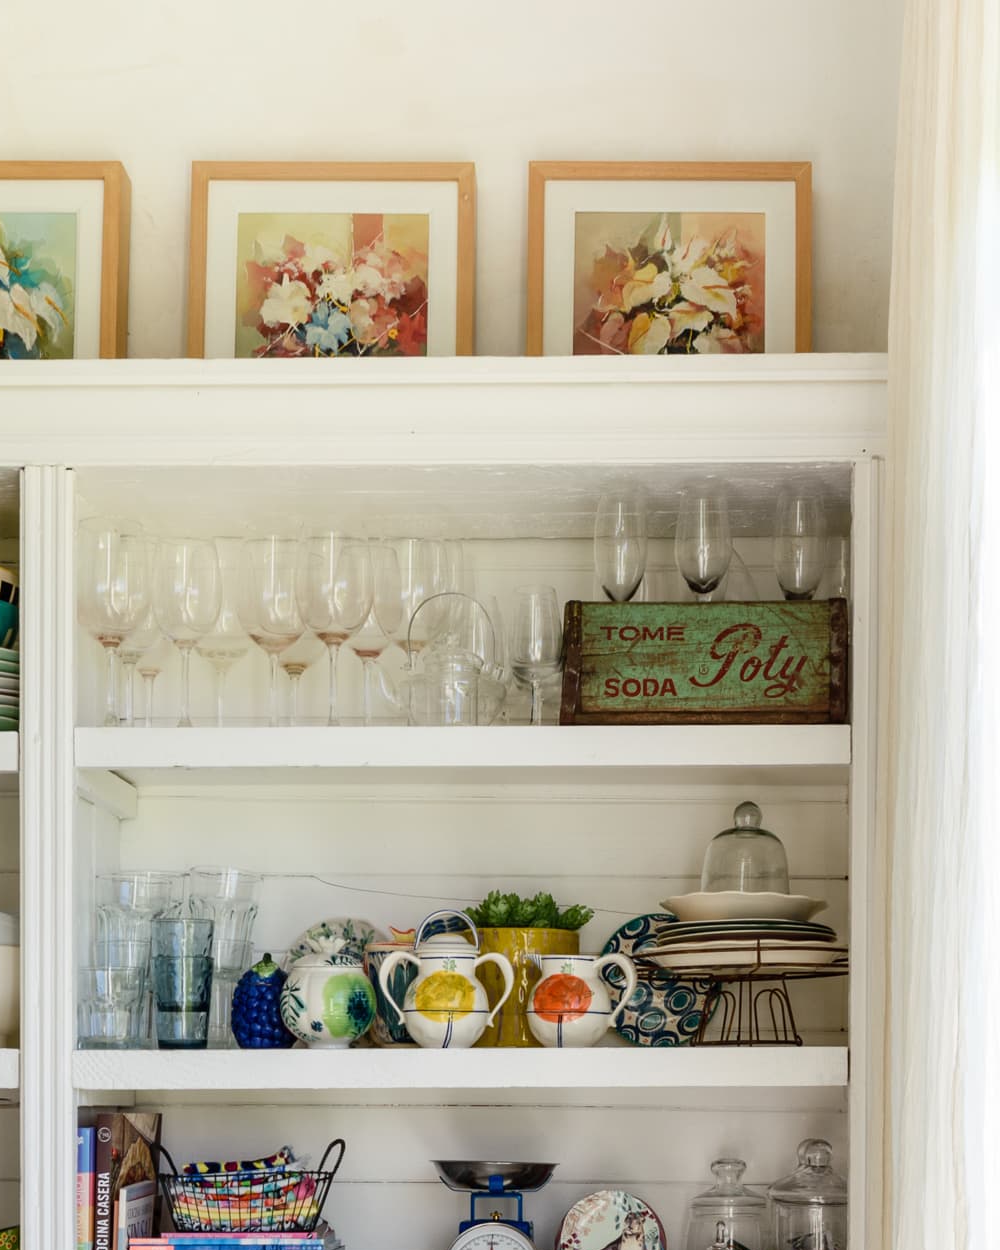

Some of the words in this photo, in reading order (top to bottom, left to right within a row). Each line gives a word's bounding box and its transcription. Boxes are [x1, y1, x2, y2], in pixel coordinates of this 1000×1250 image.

[600, 626, 687, 641] TOME
[689, 623, 809, 699] Poty
[603, 678, 678, 698] SODA
[96, 1172, 111, 1216] CASERA
